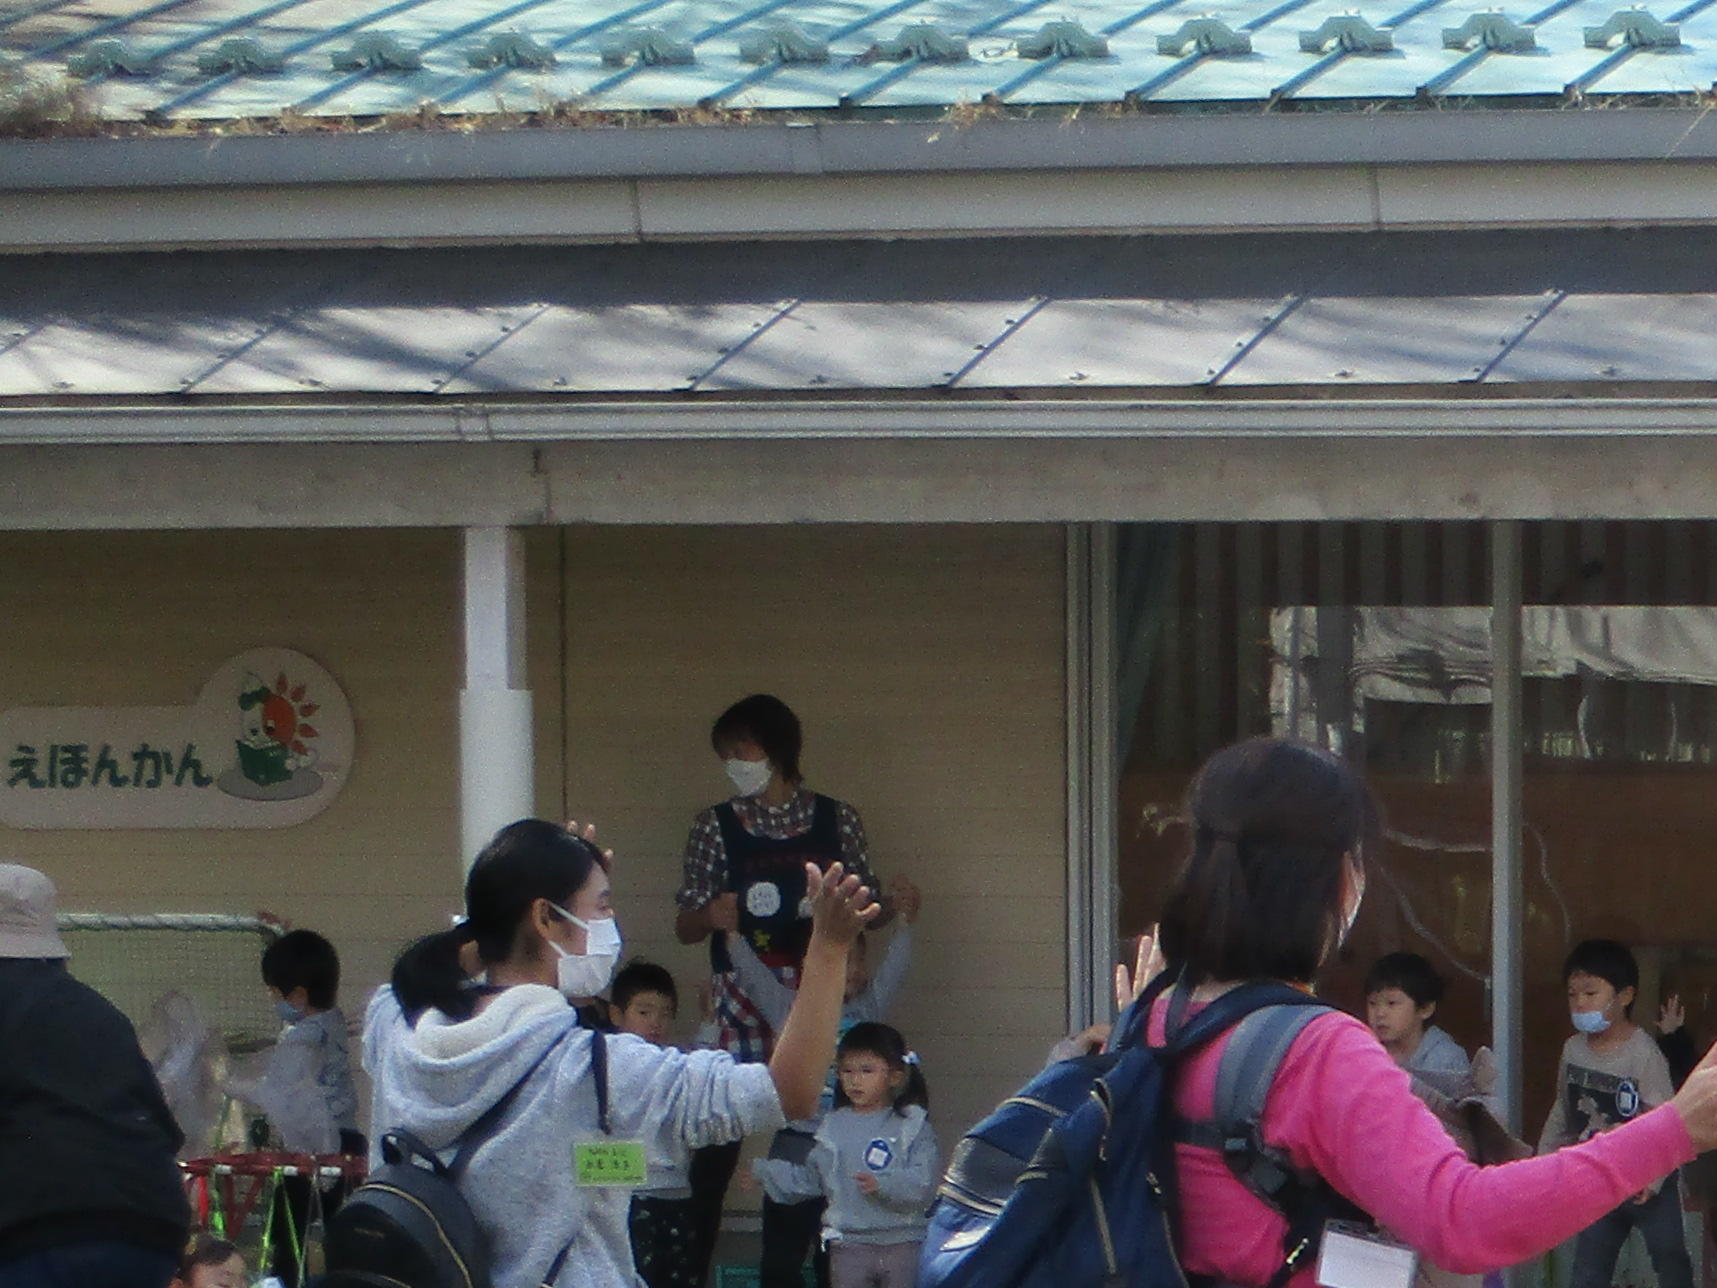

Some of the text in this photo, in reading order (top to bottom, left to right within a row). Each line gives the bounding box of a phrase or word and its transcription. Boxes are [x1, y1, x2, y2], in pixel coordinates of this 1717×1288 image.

[7, 742, 214, 789] えほんかん
